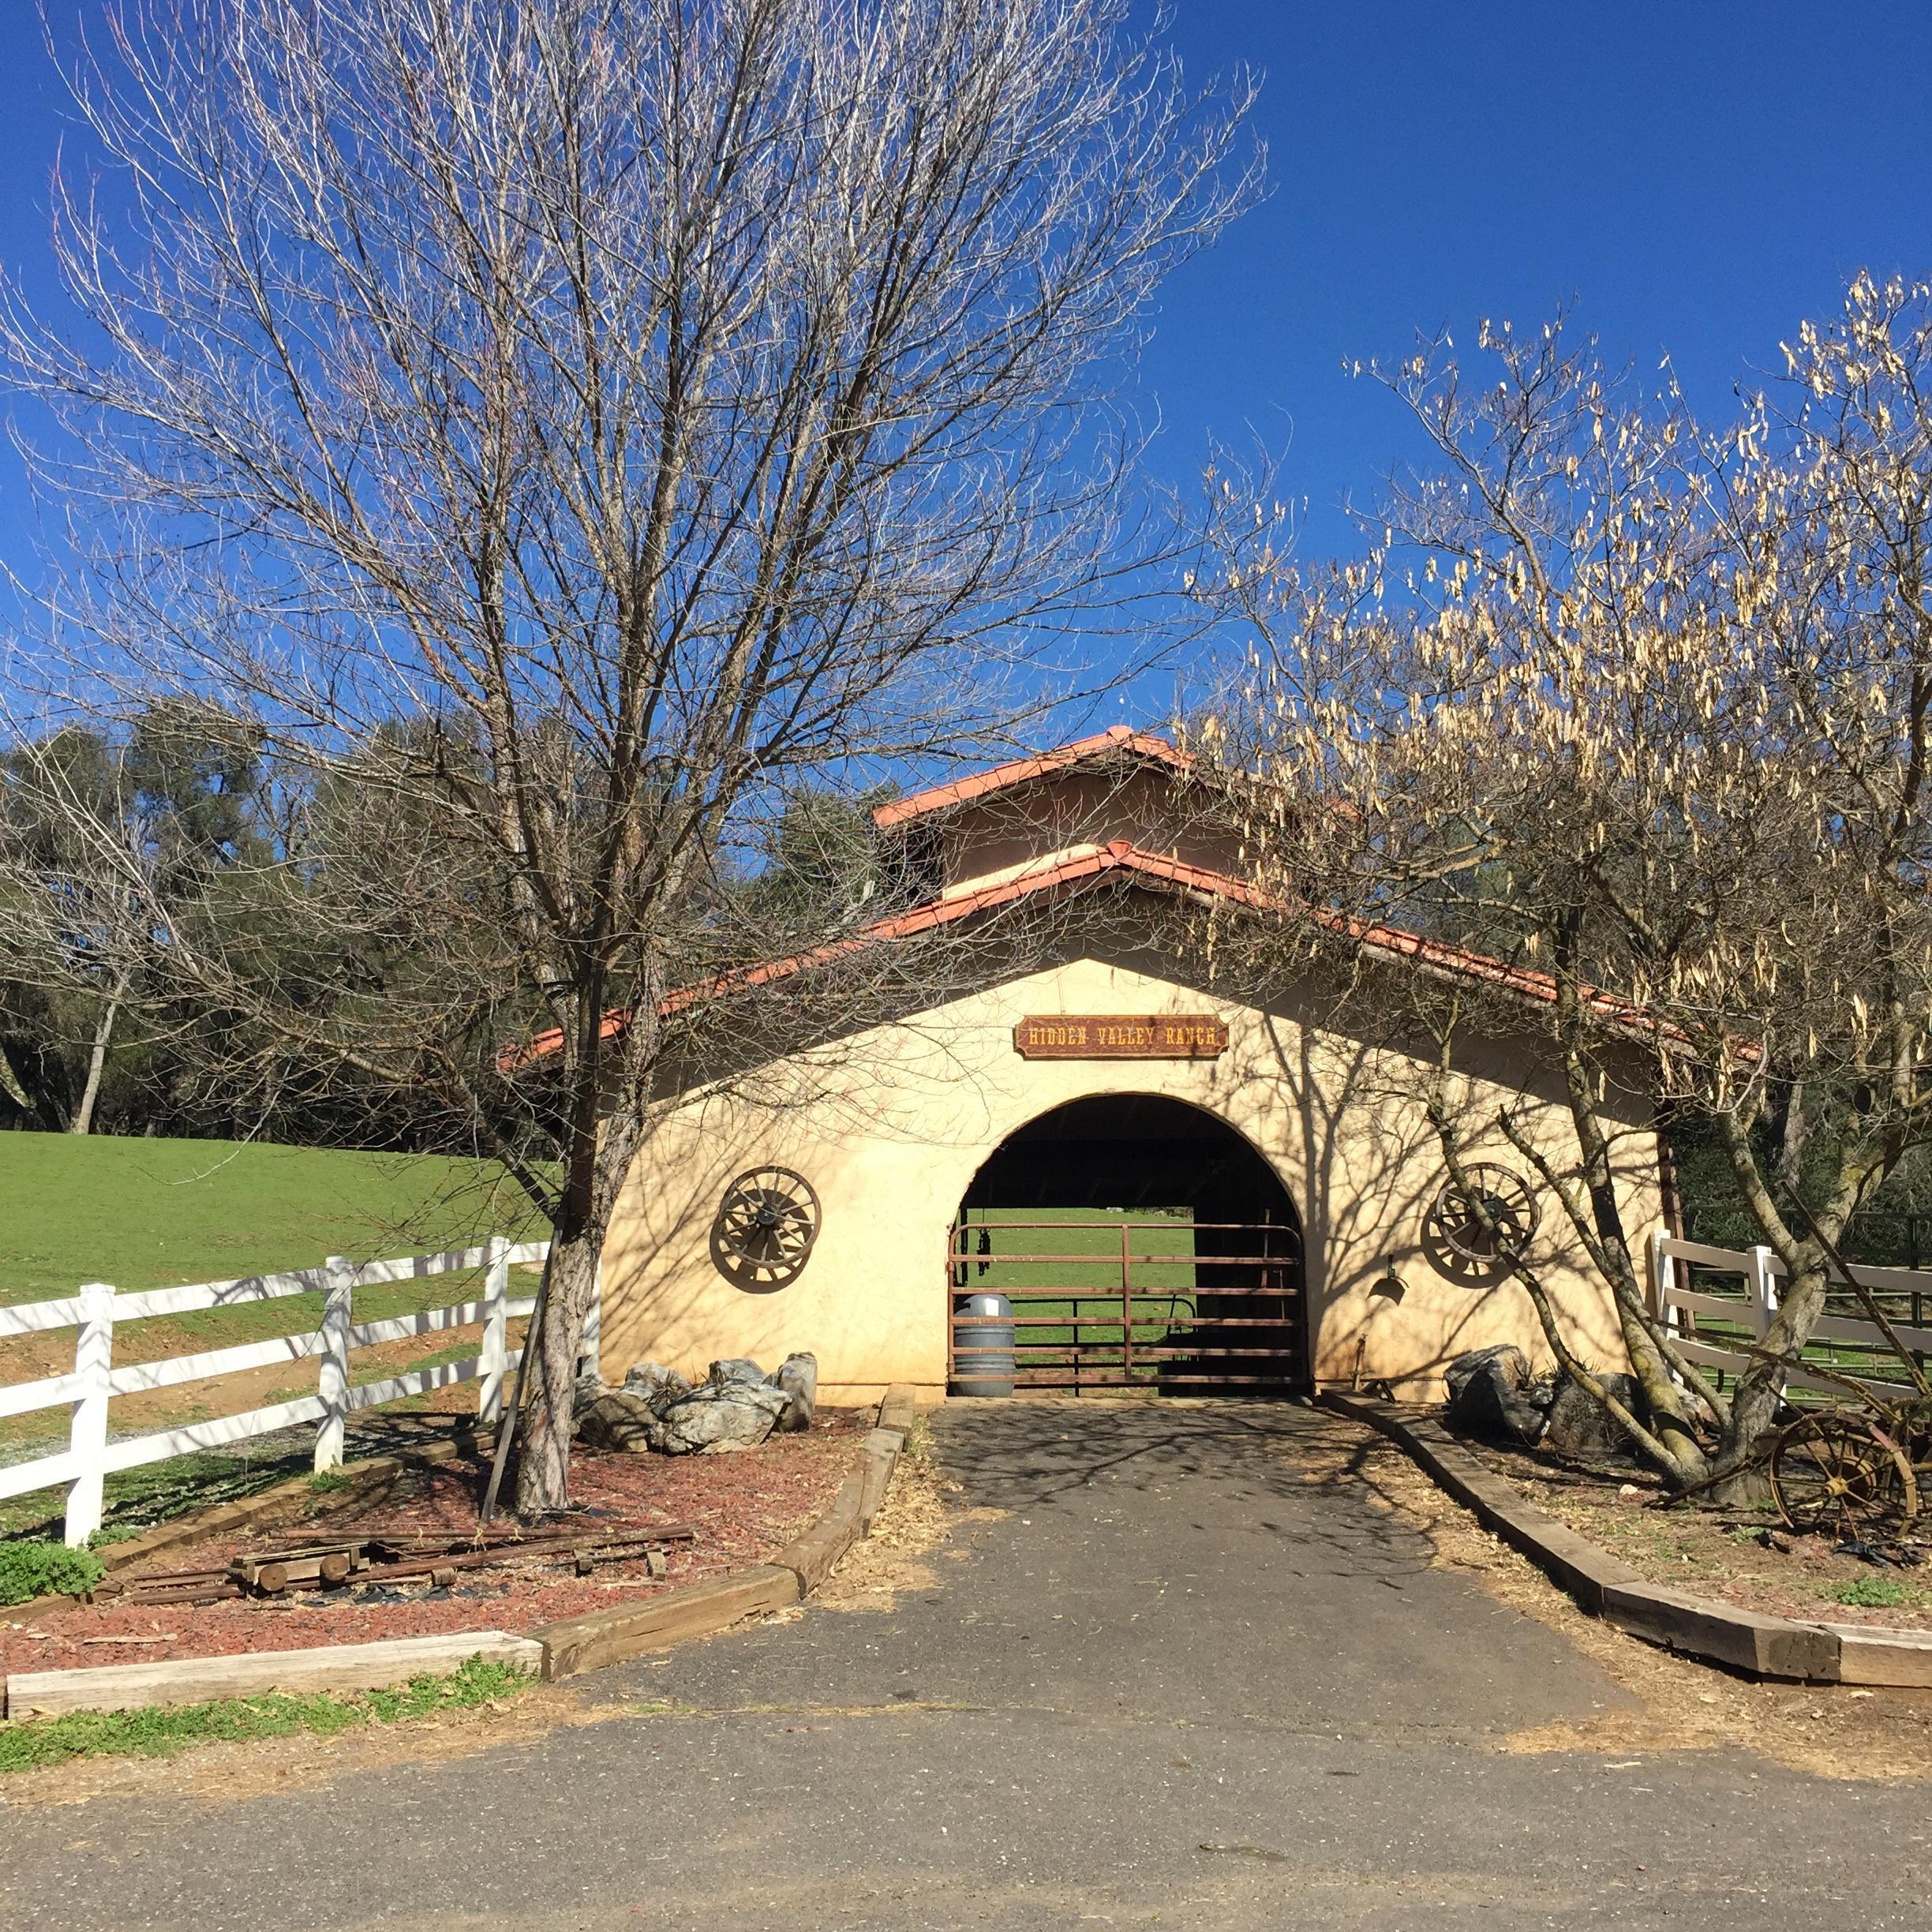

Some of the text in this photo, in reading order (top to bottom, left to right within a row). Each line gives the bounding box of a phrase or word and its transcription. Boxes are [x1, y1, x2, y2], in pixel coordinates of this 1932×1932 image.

[1029, 1027, 1215, 1045] HIDDEN VALLEY RANCH
